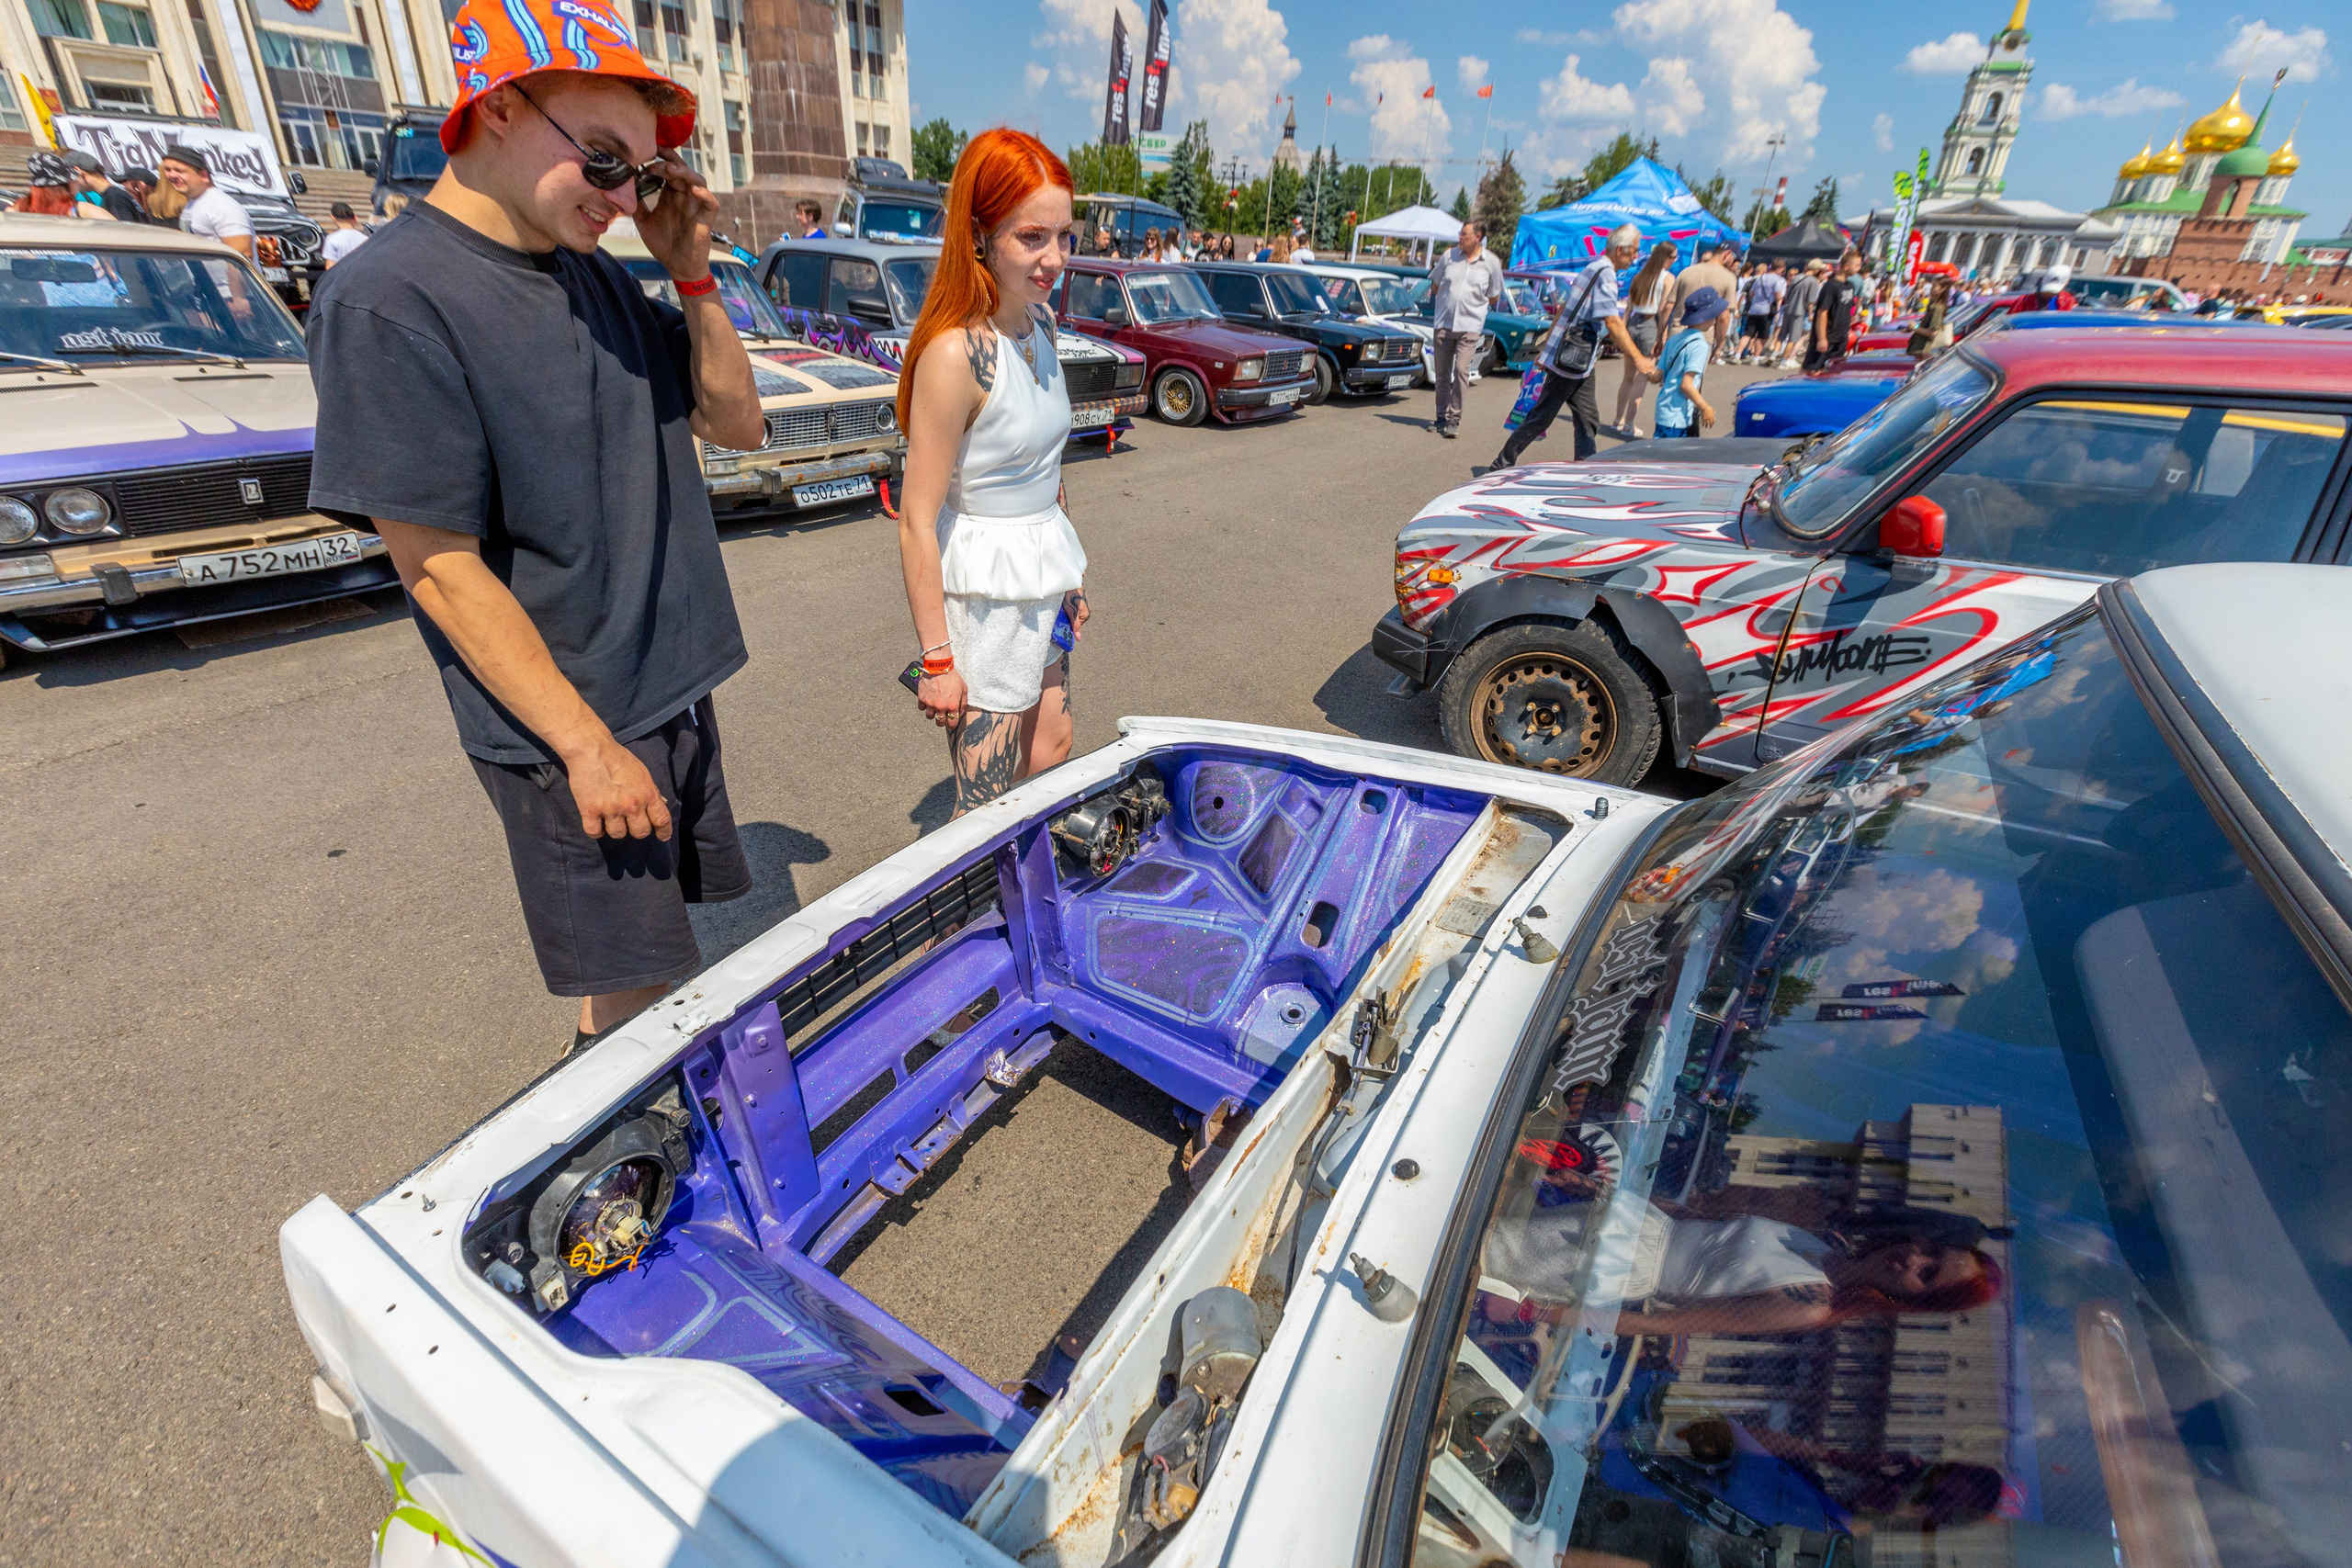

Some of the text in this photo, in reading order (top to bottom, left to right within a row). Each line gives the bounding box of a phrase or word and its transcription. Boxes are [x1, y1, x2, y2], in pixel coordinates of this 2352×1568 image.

[559, 2, 629, 42] EXHAUST
[1569, 202, 1668, 217] AUTOFANATIC.RU
[1071, 412, 1101, 427] 908СУ
[800, 476, 868, 503] О502ТЕ 71
[200, 536, 351, 581] А752МН 32
[325, 555, 345, 563] RUS
[1553, 915, 1668, 1091] ost jam
